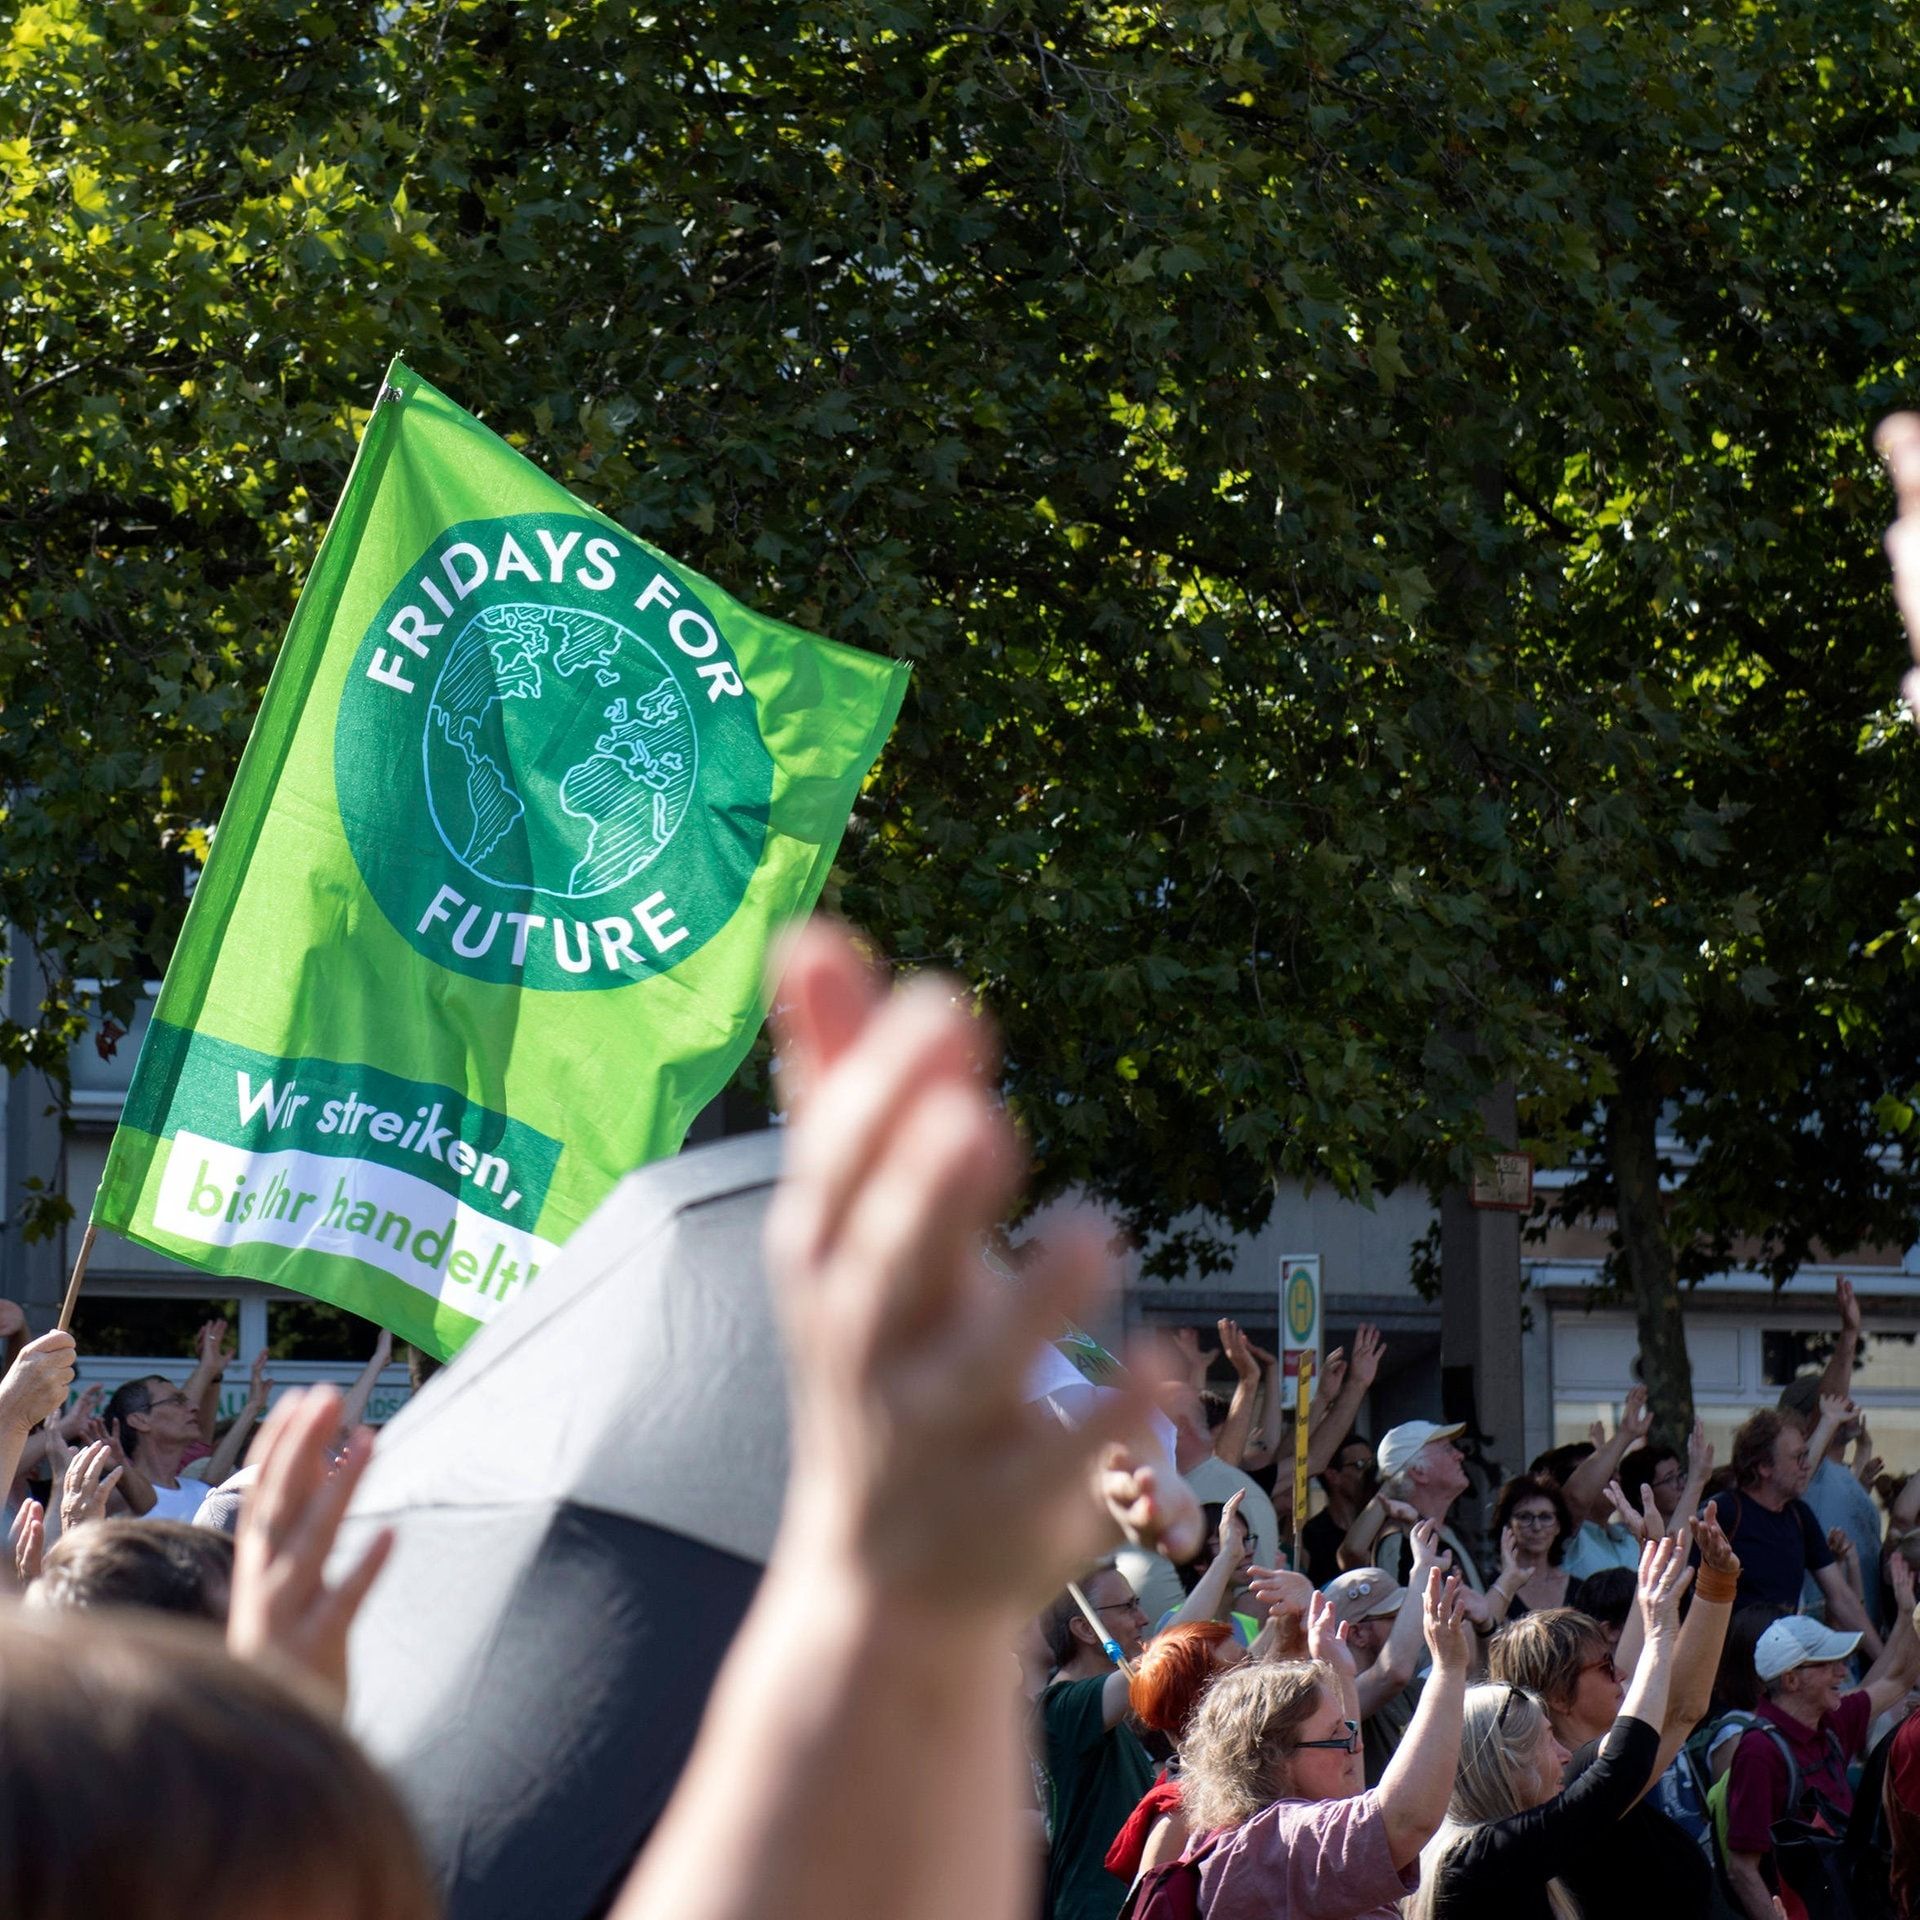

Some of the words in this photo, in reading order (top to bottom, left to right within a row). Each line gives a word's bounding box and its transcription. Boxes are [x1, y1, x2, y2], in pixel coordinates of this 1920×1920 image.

[366, 530, 621, 694] FRIDAYS
[634, 573, 743, 702] FOR
[415, 883, 690, 973] FUTURE
[186, 1159, 256, 1224] bis
[257, 1168, 318, 1224] Ihr
[236, 1071, 309, 1132] Wir
[316, 1091, 523, 1211] streiken,
